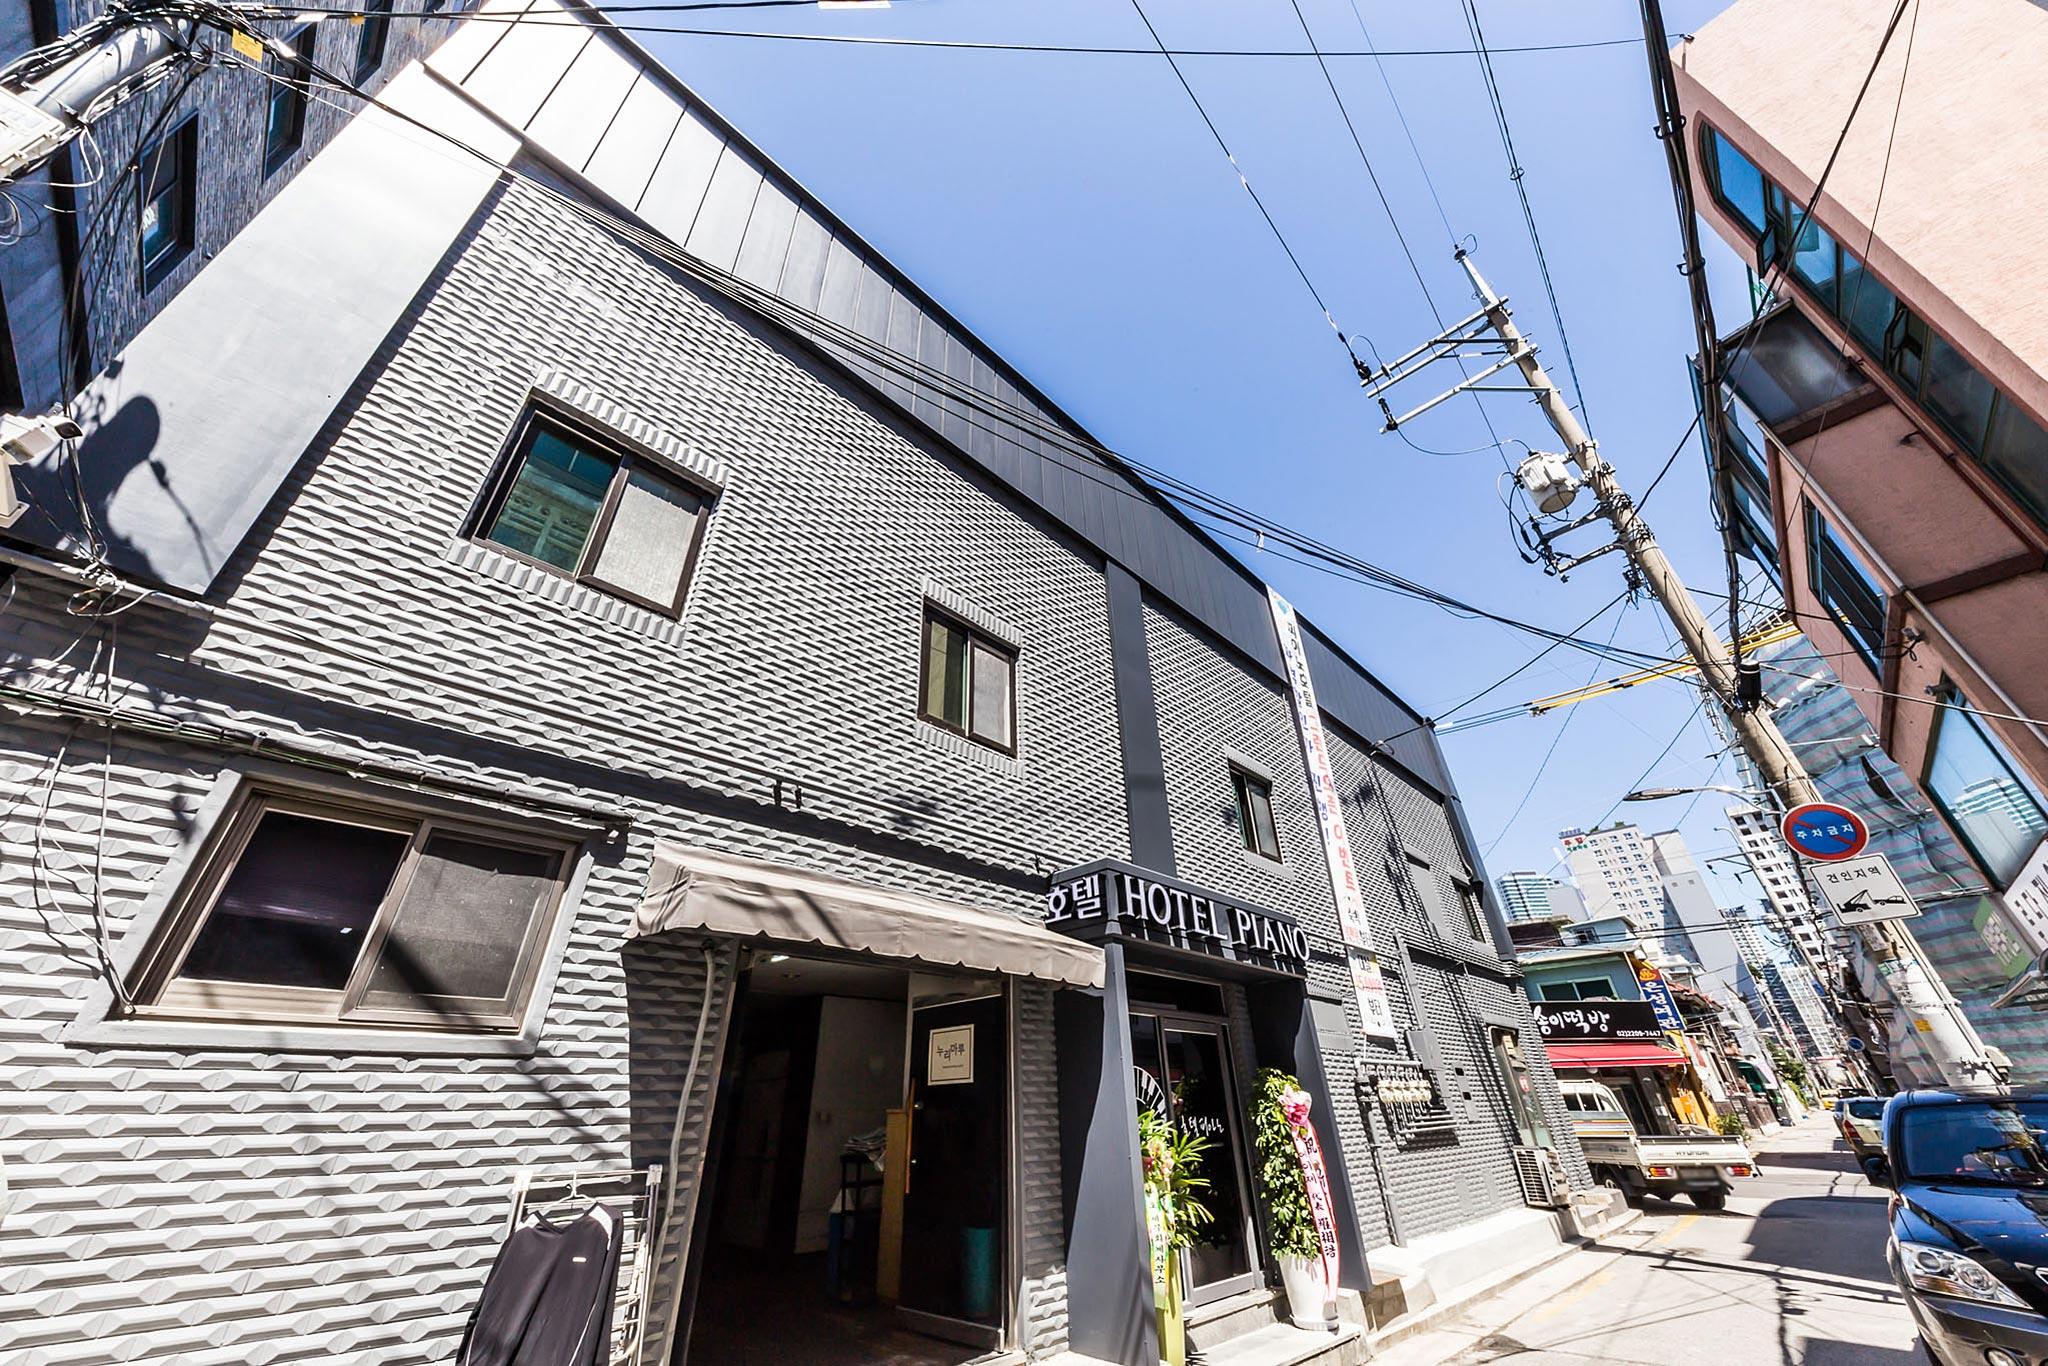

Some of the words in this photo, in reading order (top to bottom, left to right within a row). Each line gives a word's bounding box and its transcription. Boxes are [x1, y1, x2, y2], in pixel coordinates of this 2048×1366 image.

[1796, 823, 1854, 840] 주차금지
[1826, 866, 1882, 885] 견인지역
[1045, 873, 1102, 923] 호텔
[1124, 874, 1228, 941] HOTEL
[1234, 909, 1311, 962] PIANO
[936, 1042, 965, 1061] 누리마루
